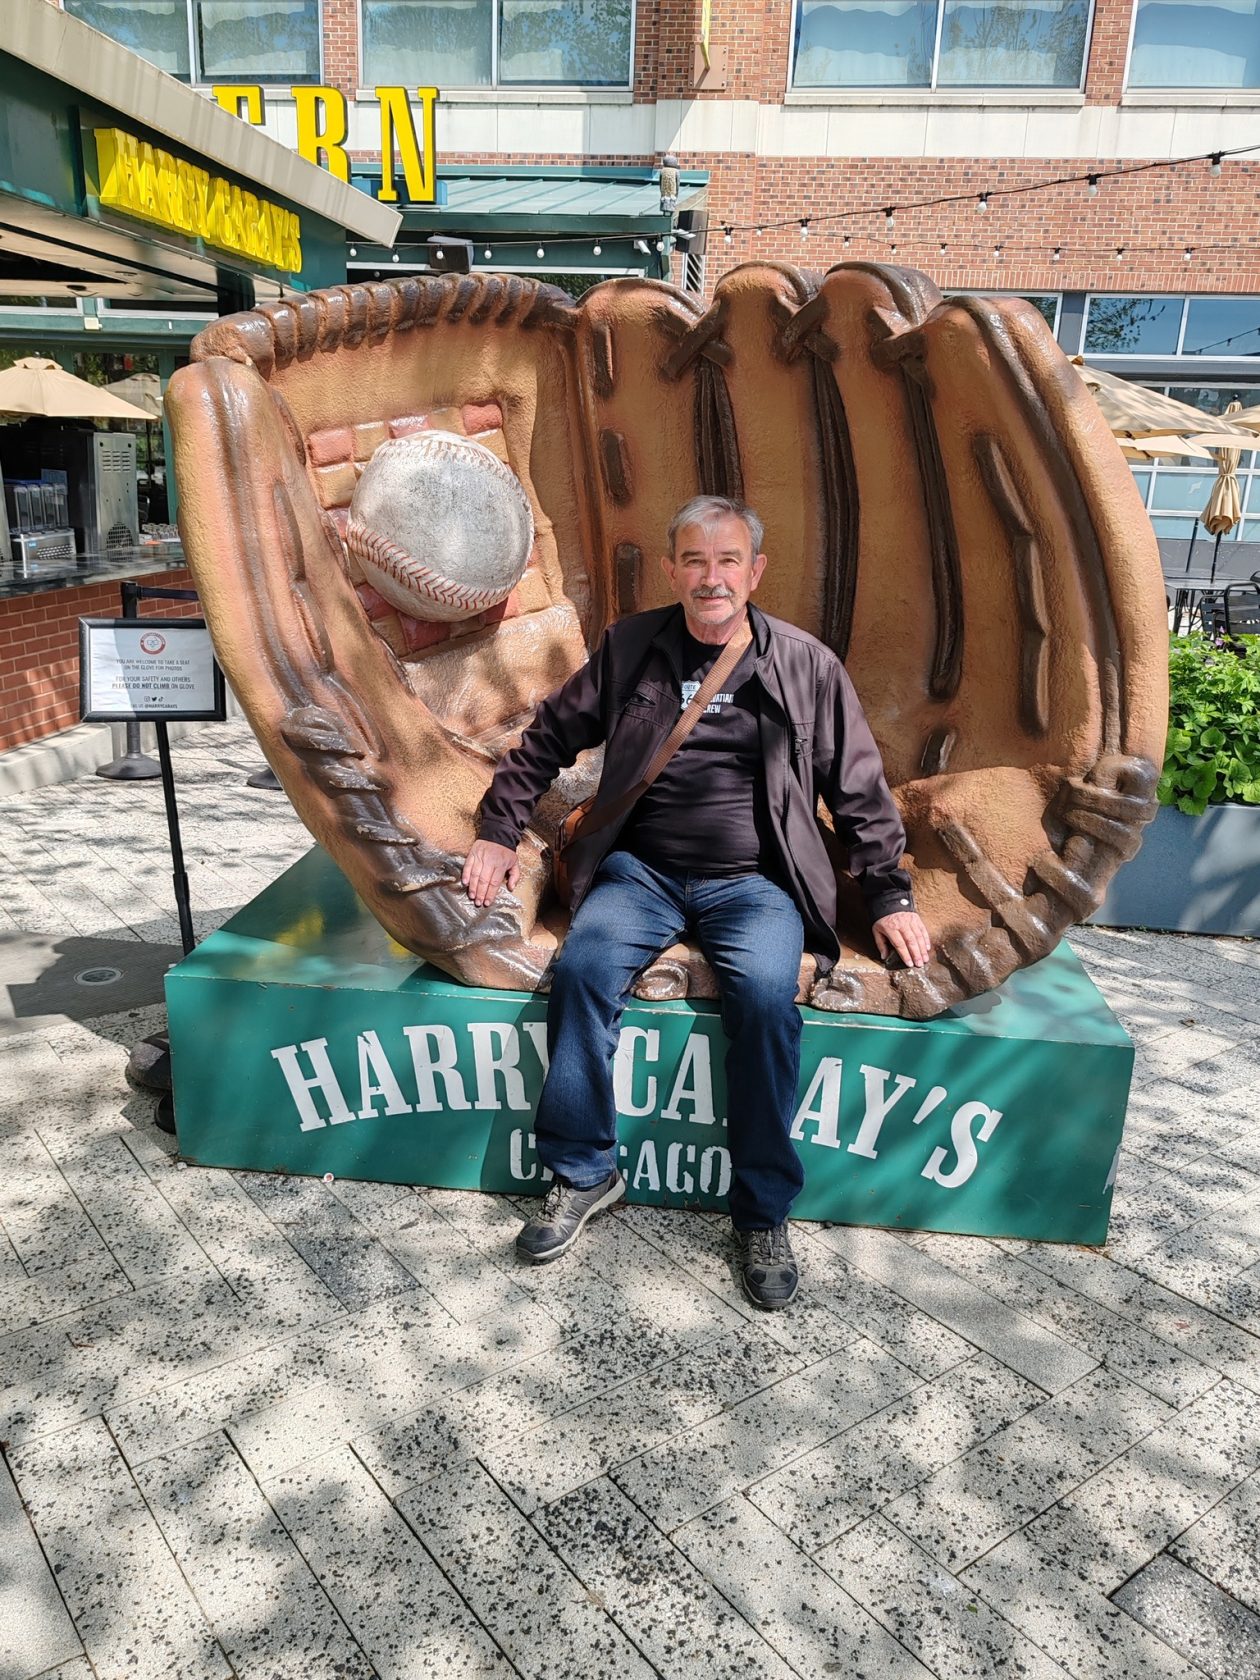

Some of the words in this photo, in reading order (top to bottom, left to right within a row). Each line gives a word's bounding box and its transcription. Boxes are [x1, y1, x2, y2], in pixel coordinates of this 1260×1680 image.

[94, 127, 210, 240] HARRY
[204, 177, 303, 273] CARAY'S
[703, 704, 721, 714] REW
[612, 1026, 1003, 1188] CAAY'S
[510, 1128, 732, 1197] CAGO
